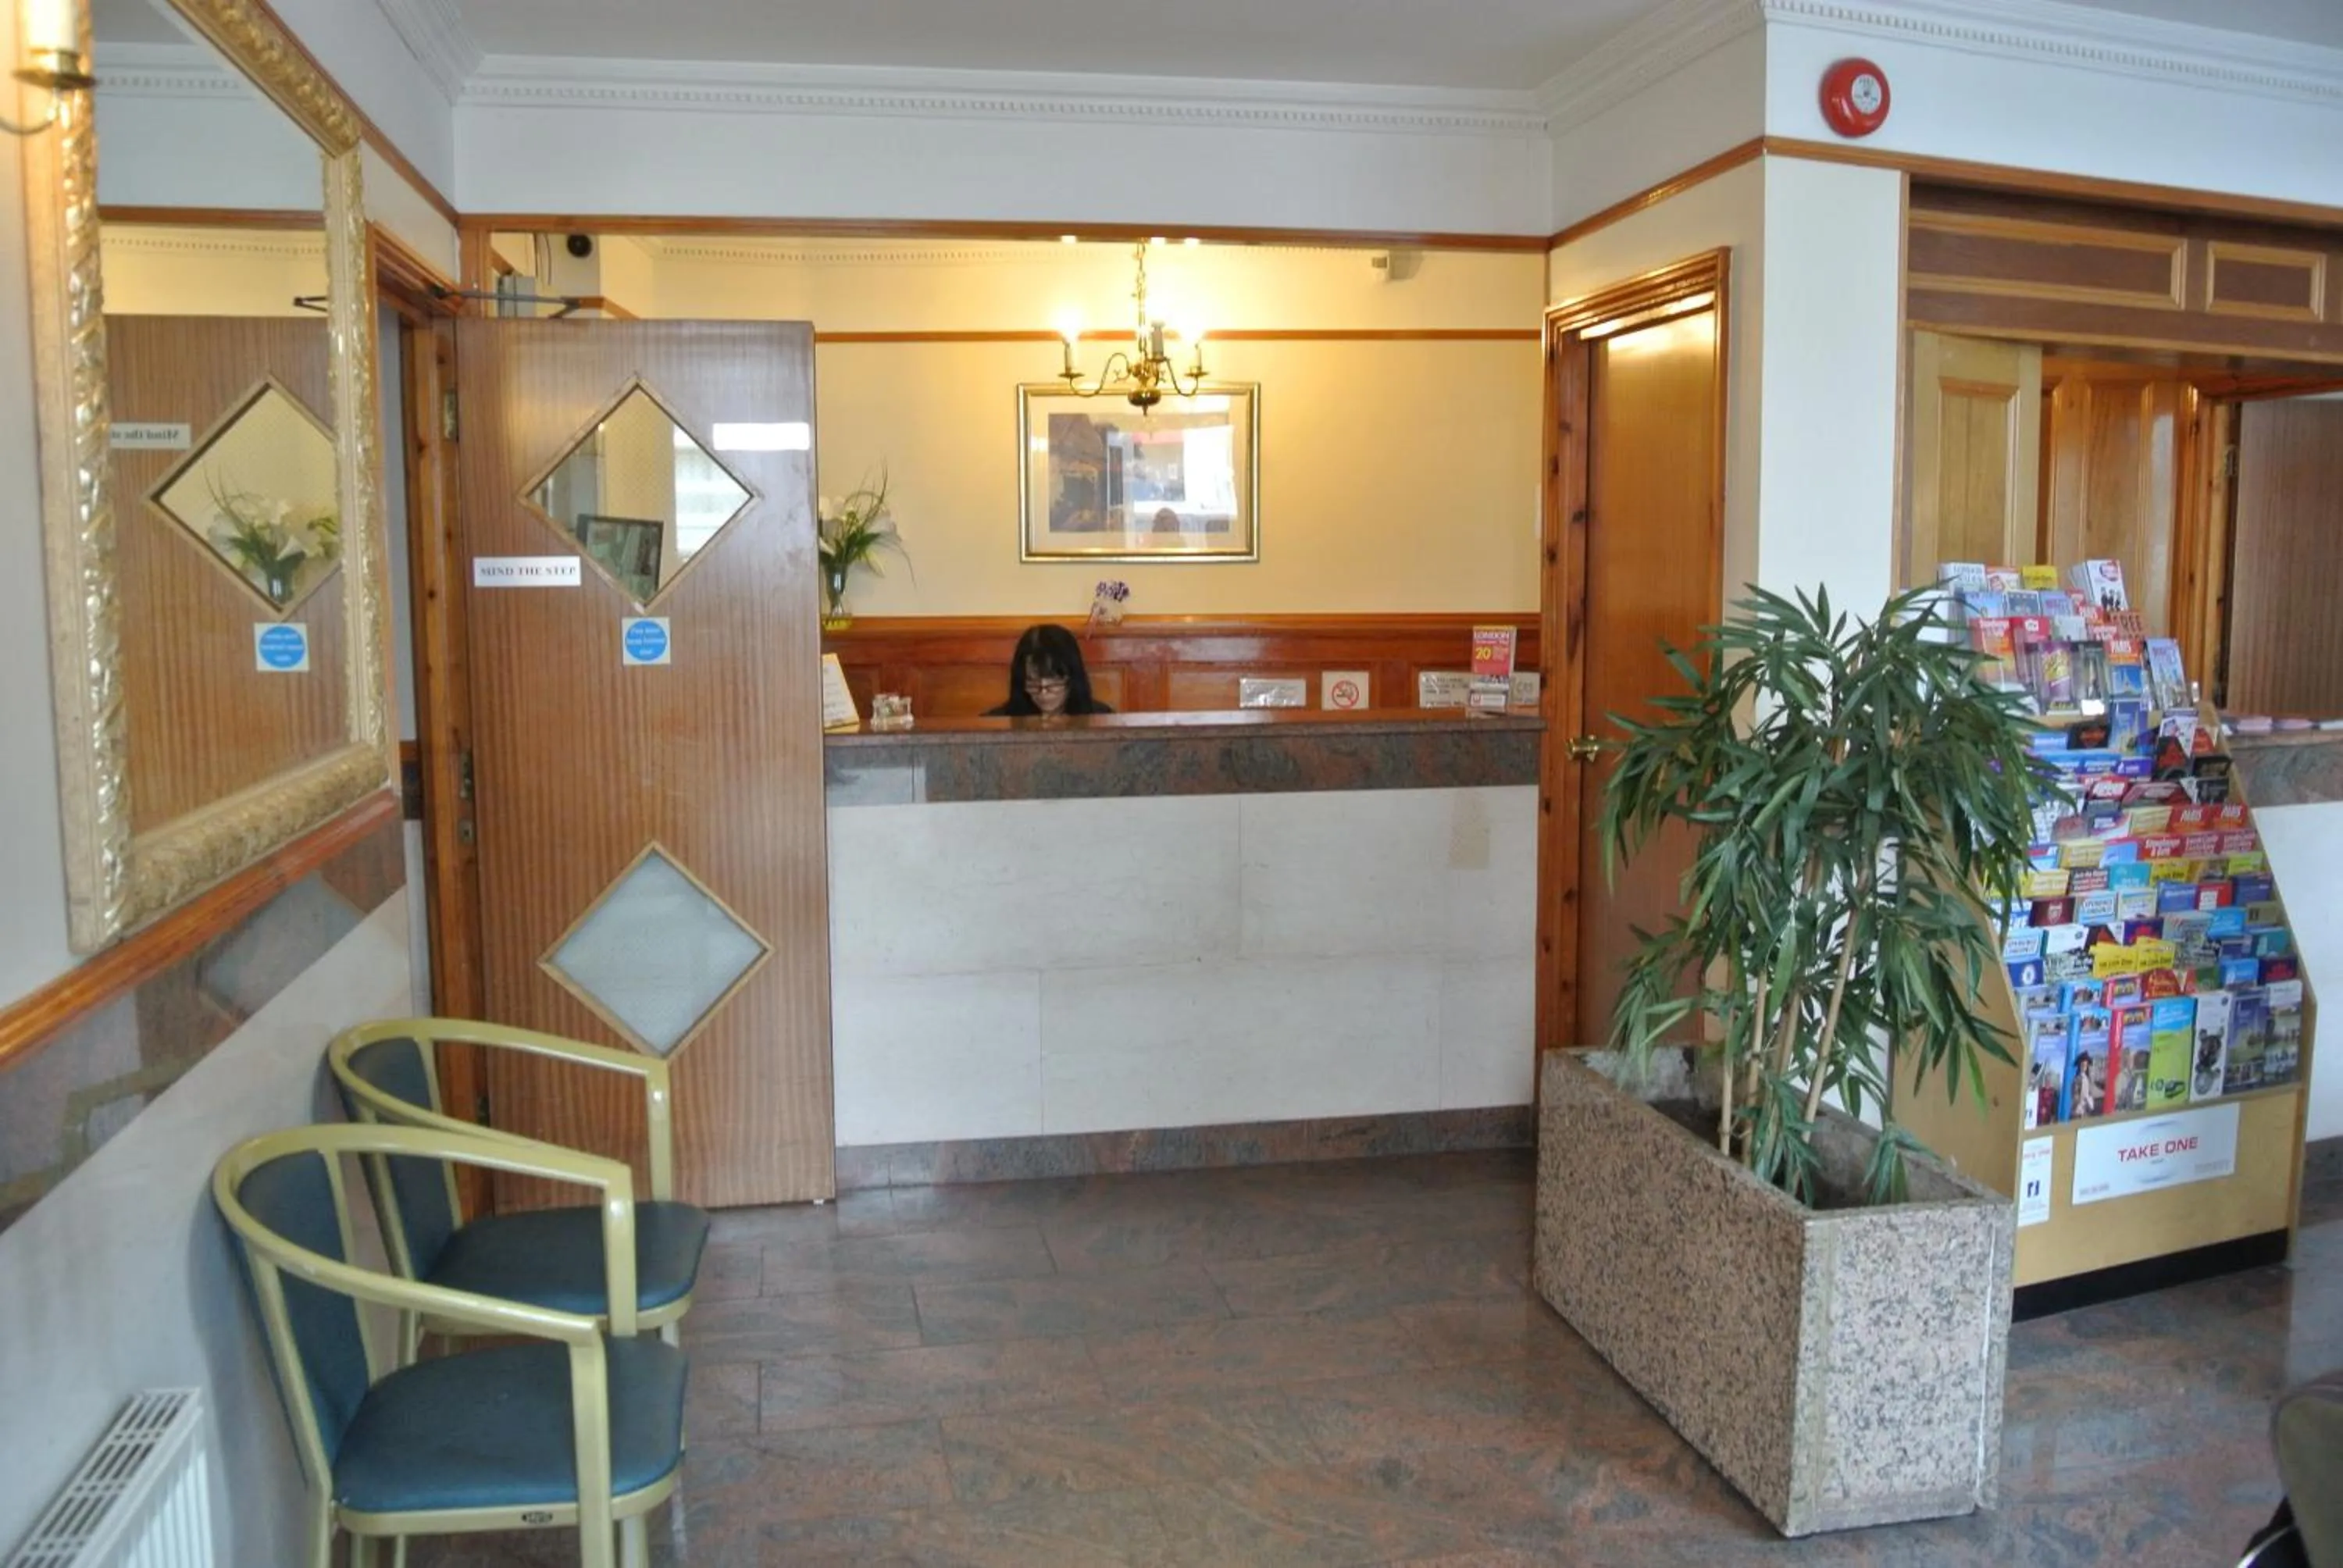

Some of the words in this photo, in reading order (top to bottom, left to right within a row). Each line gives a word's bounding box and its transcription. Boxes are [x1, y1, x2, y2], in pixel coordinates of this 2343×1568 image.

[480, 567, 514, 576] MIND
[518, 567, 540, 576] THE
[545, 566, 576, 576] STEP
[1475, 647, 1492, 661] 20
[2117, 1143, 2160, 1163] TAKE
[2164, 1136, 2199, 1154] ONE
